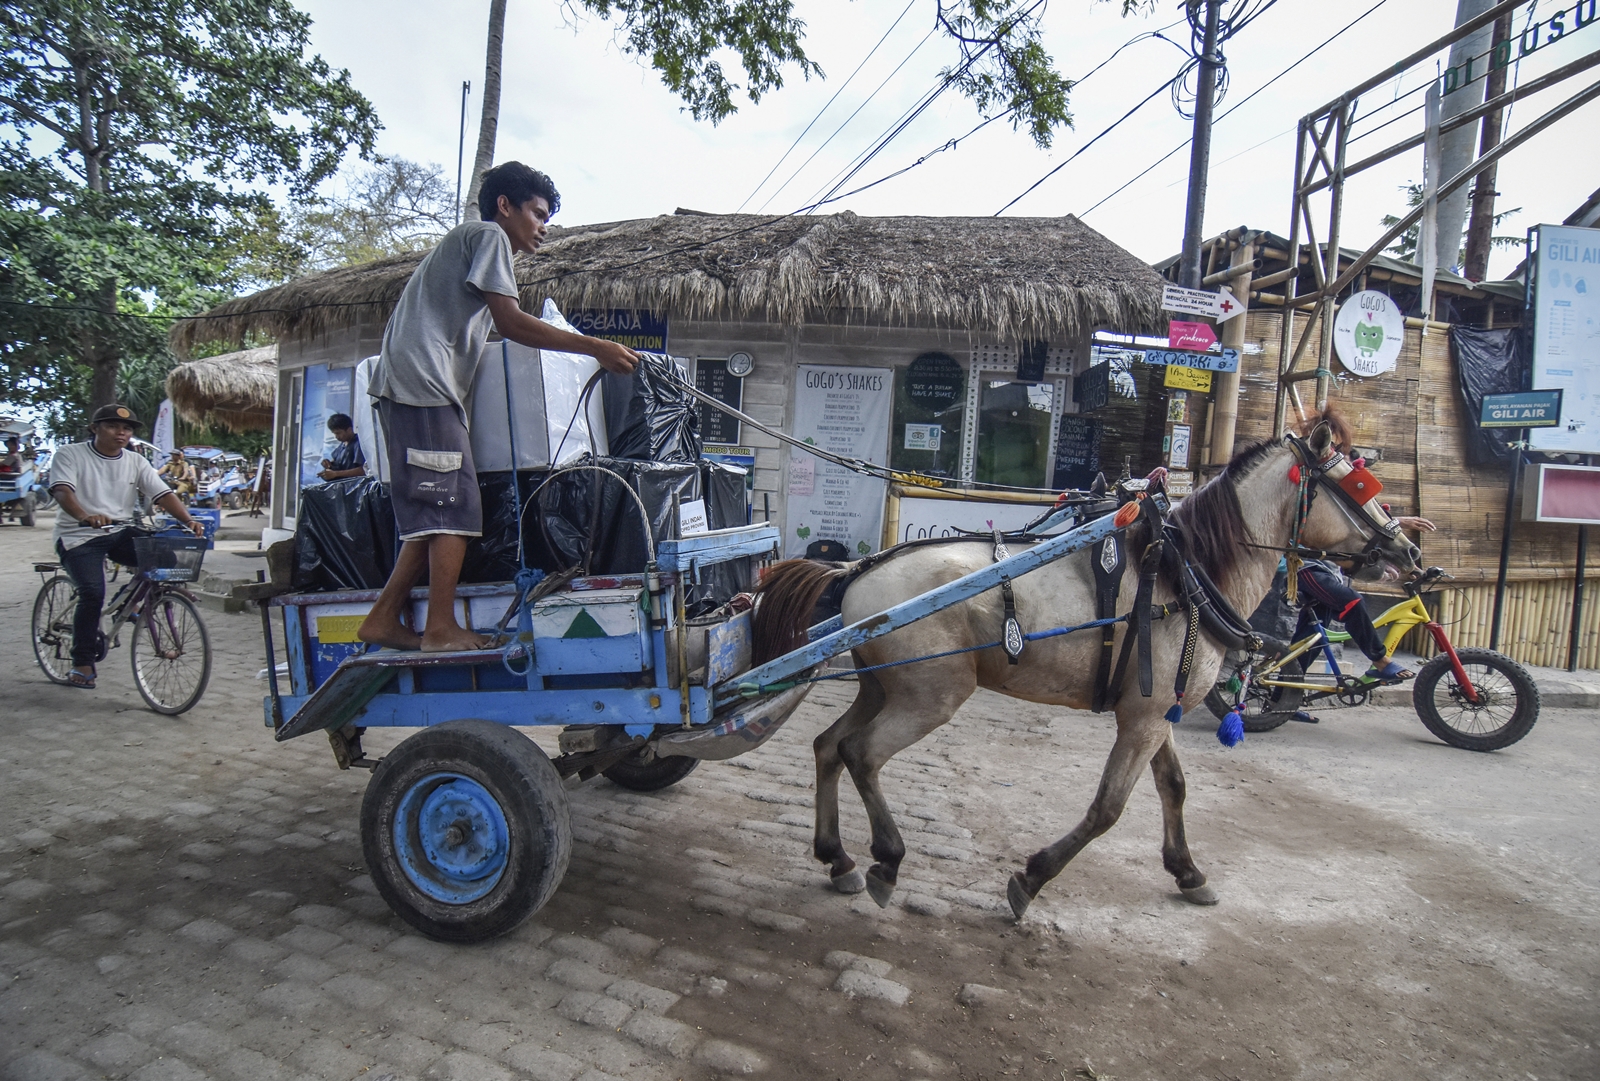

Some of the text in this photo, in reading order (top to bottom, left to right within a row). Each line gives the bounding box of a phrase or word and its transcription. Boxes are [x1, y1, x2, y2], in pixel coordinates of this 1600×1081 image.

[1443, 57, 1473, 95] DI
[1548, 244, 1578, 262] GILI
[1187, 290, 1216, 300] PRACTITIONER
[1360, 294, 1386, 312] GOGO'S
[1352, 356, 1378, 374] SHAKES
[846, 373, 882, 391] SHAKES
[1492, 409, 1545, 418] GILI AIR
[1060, 433, 1086, 441] BANANA
[1061, 425, 1091, 434] COCONUT
